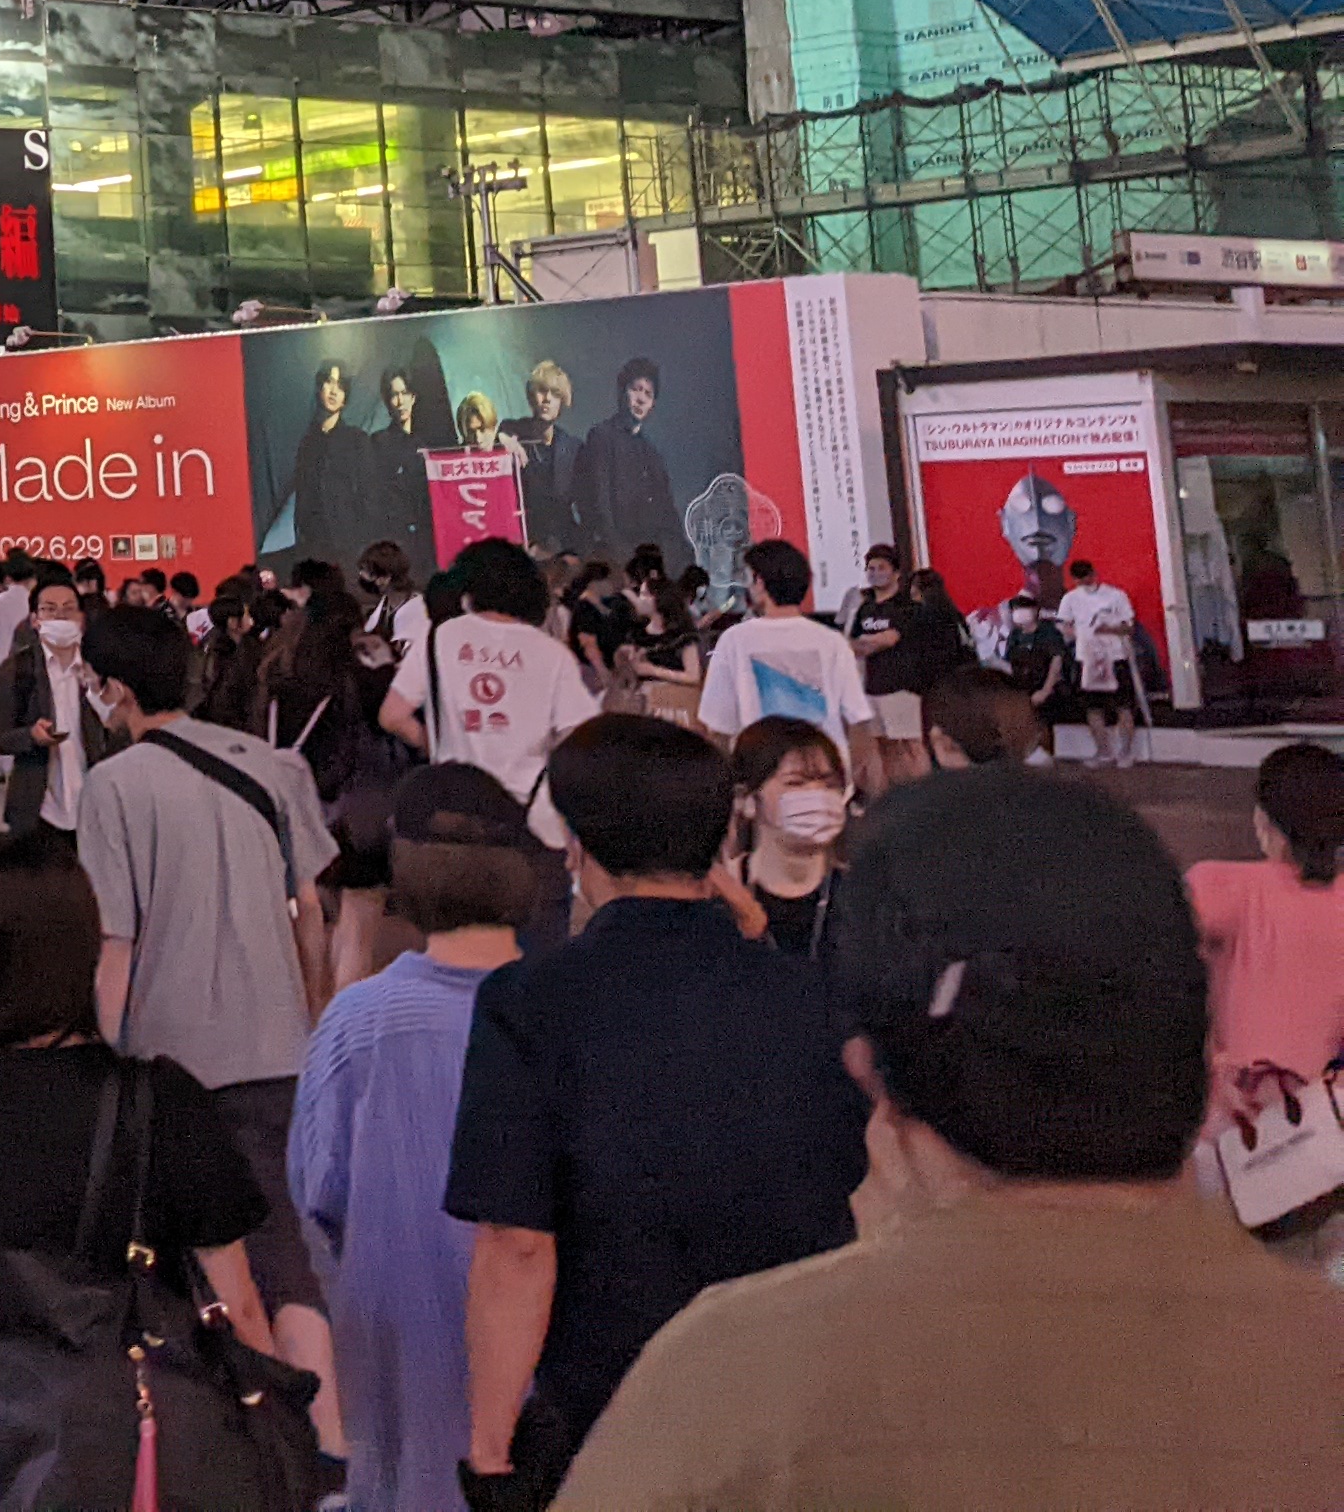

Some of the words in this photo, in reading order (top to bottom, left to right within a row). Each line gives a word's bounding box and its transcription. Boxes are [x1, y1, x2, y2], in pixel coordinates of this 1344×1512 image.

[42, 393, 99, 416] Prince
[106, 398, 133, 412] New
[136, 394, 176, 409] Album
[153, 434, 215, 497] in
